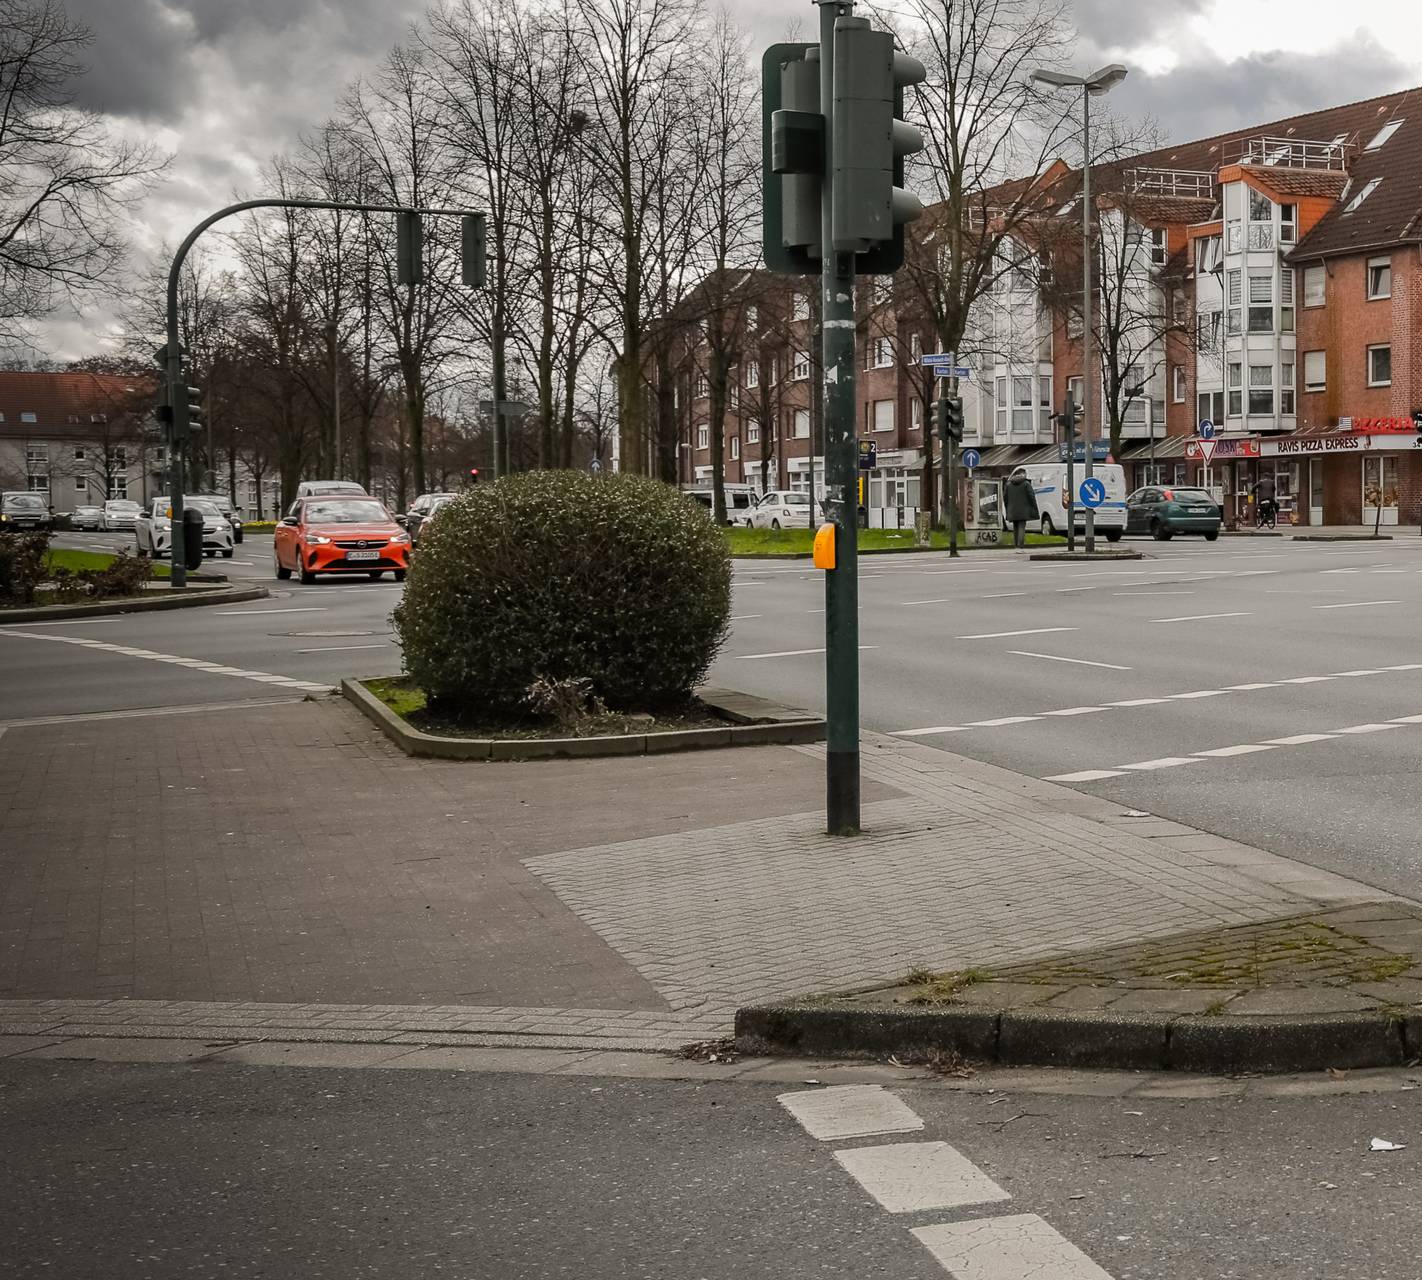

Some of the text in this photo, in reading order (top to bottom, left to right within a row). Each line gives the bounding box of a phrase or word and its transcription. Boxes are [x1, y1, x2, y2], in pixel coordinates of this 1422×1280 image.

[870, 443, 876, 453] 2
[1277, 437, 1359, 453] RAVIS PIZZA EXPRESS
